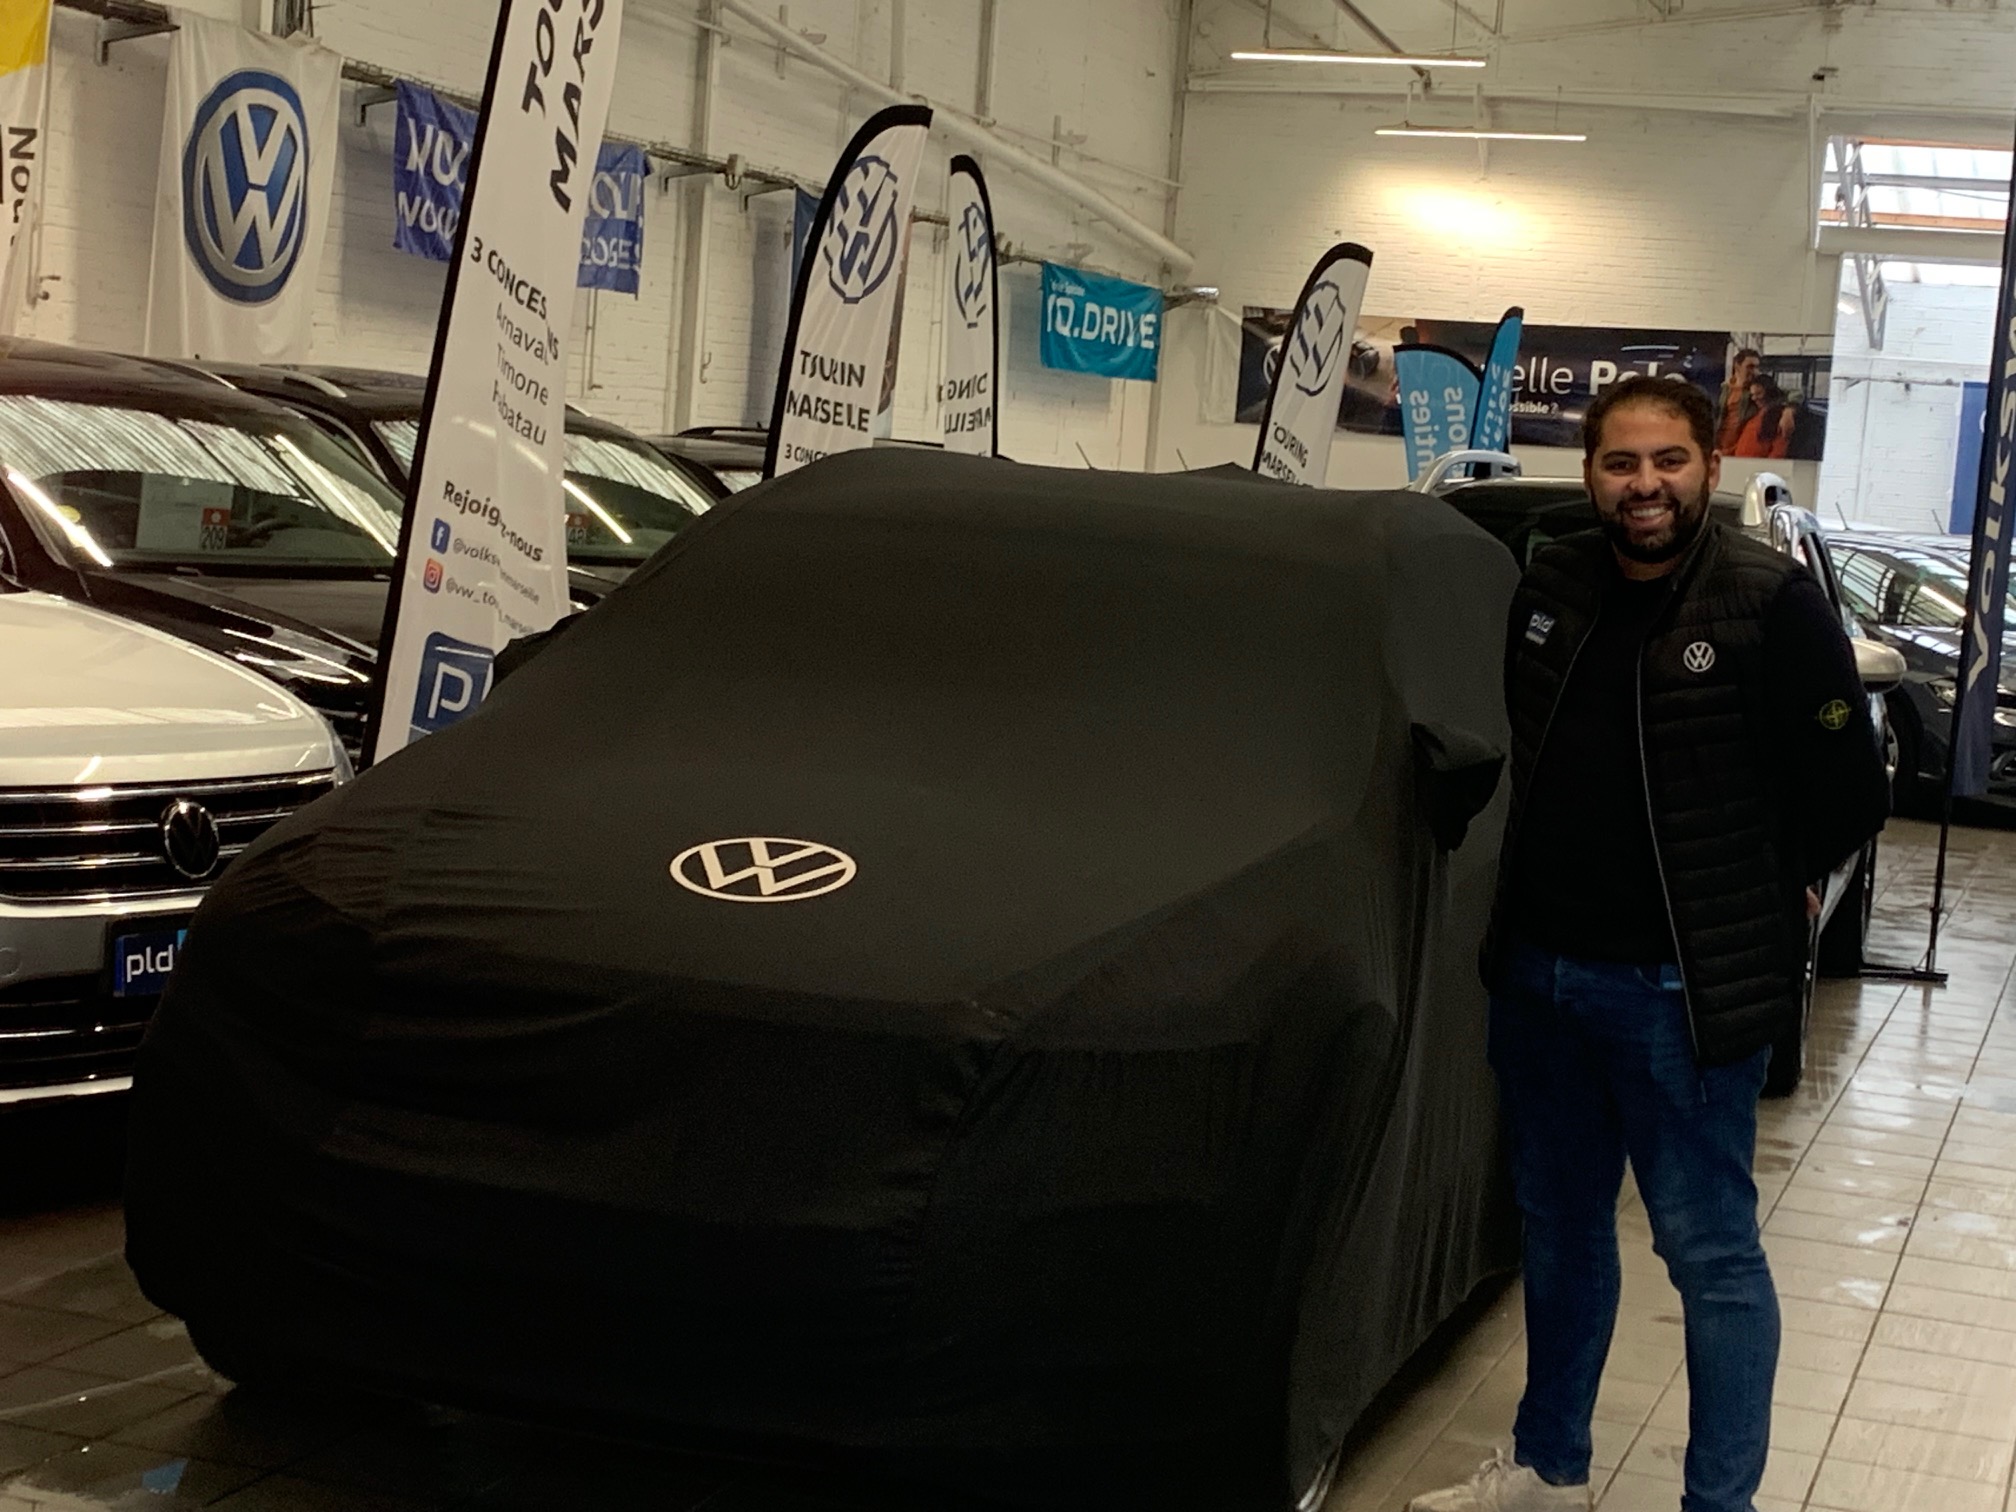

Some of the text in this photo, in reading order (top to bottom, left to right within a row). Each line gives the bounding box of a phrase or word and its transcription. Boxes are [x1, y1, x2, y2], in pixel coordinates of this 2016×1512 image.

[470, 236, 484, 264] 3
[1512, 356, 1574, 395] elle
[126, 943, 174, 984] pld
